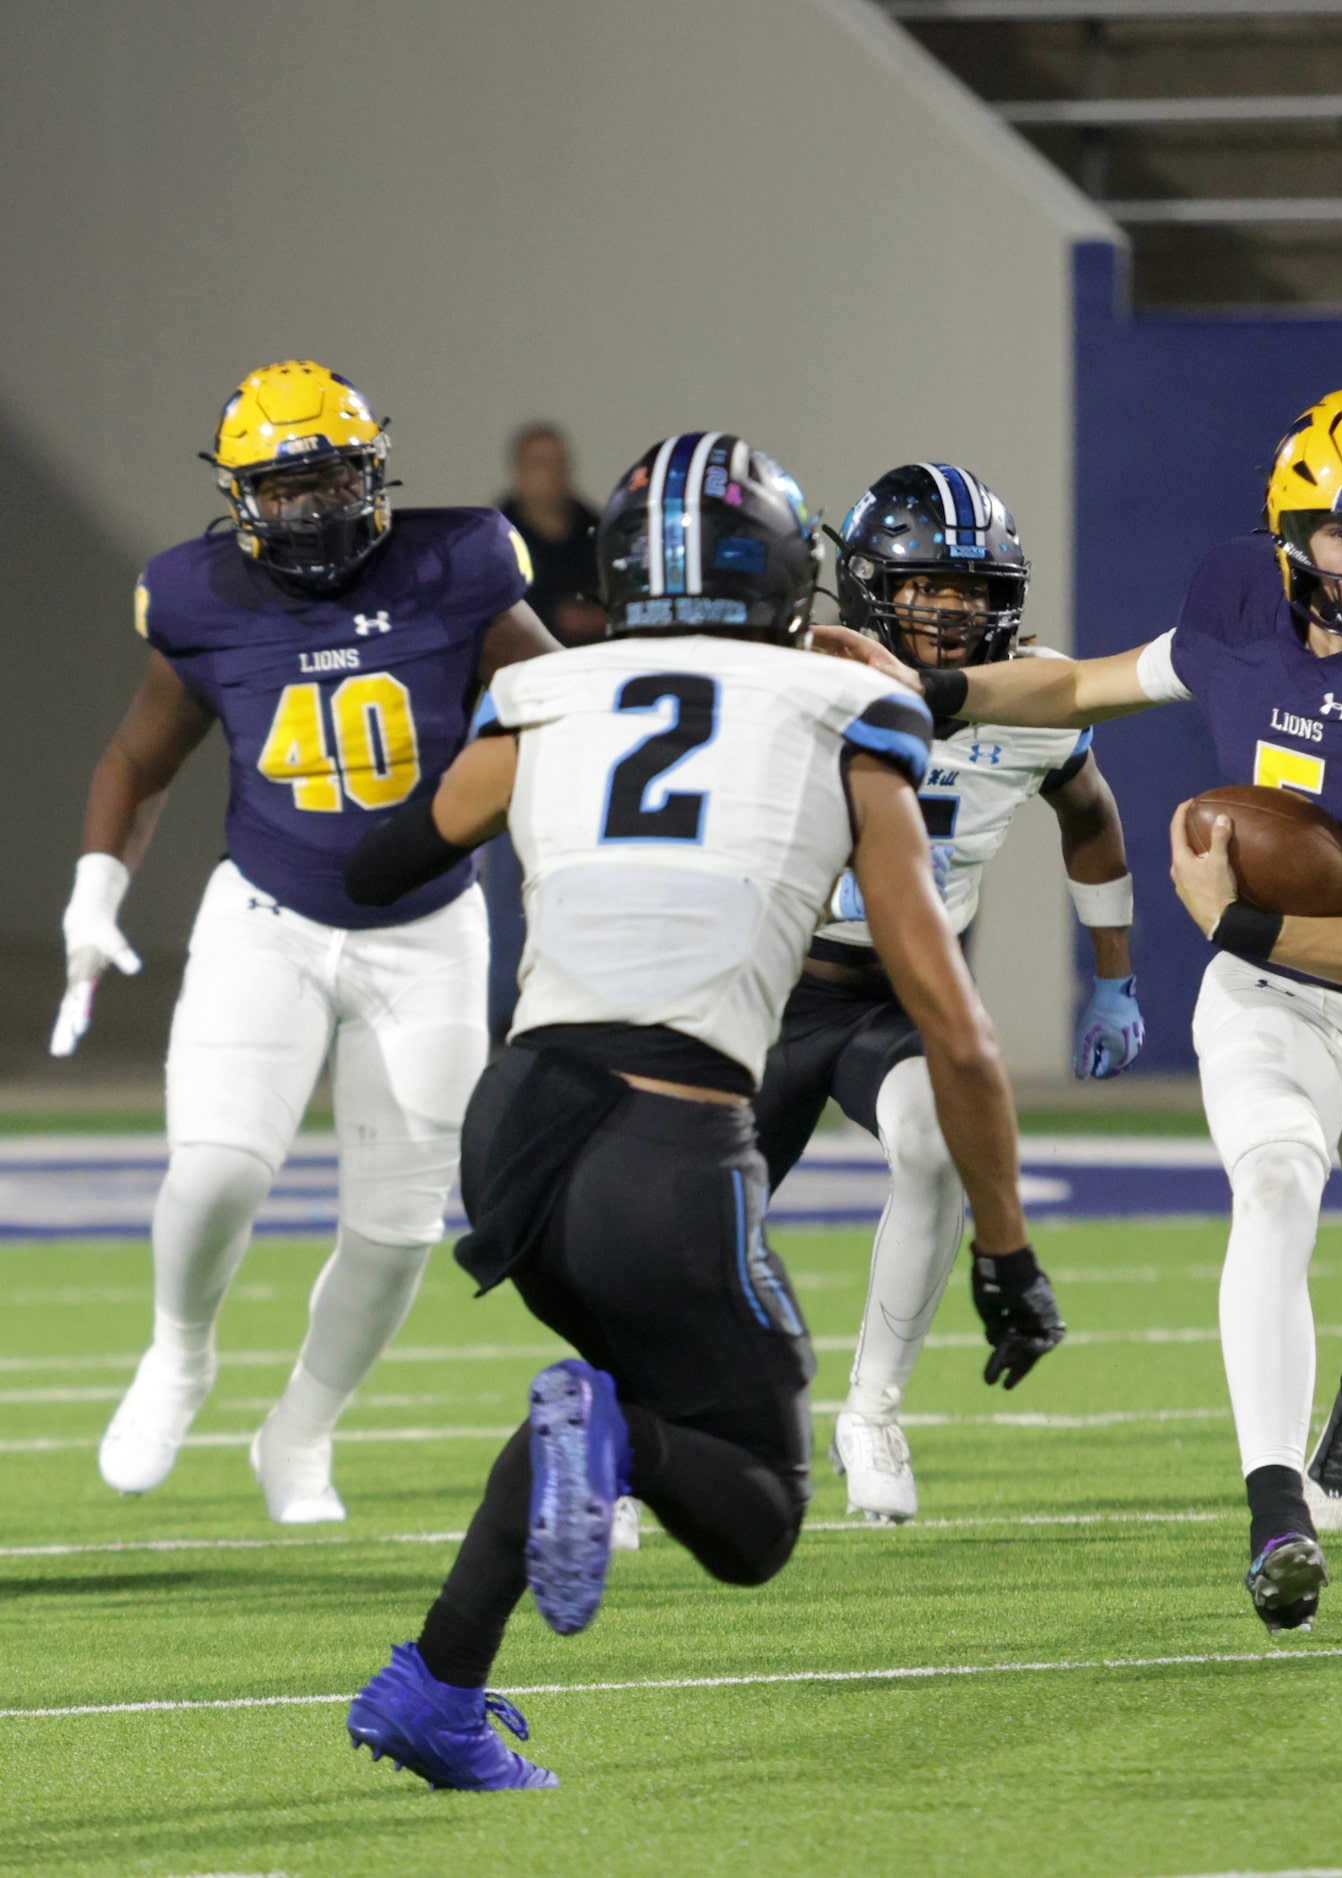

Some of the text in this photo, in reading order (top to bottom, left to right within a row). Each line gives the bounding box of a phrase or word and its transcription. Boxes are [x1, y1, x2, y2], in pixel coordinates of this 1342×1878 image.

[299, 648, 360, 673] LIONS
[257, 671, 421, 813] 40
[598, 672, 722, 846] 2
[1270, 707, 1324, 743] LIONS
